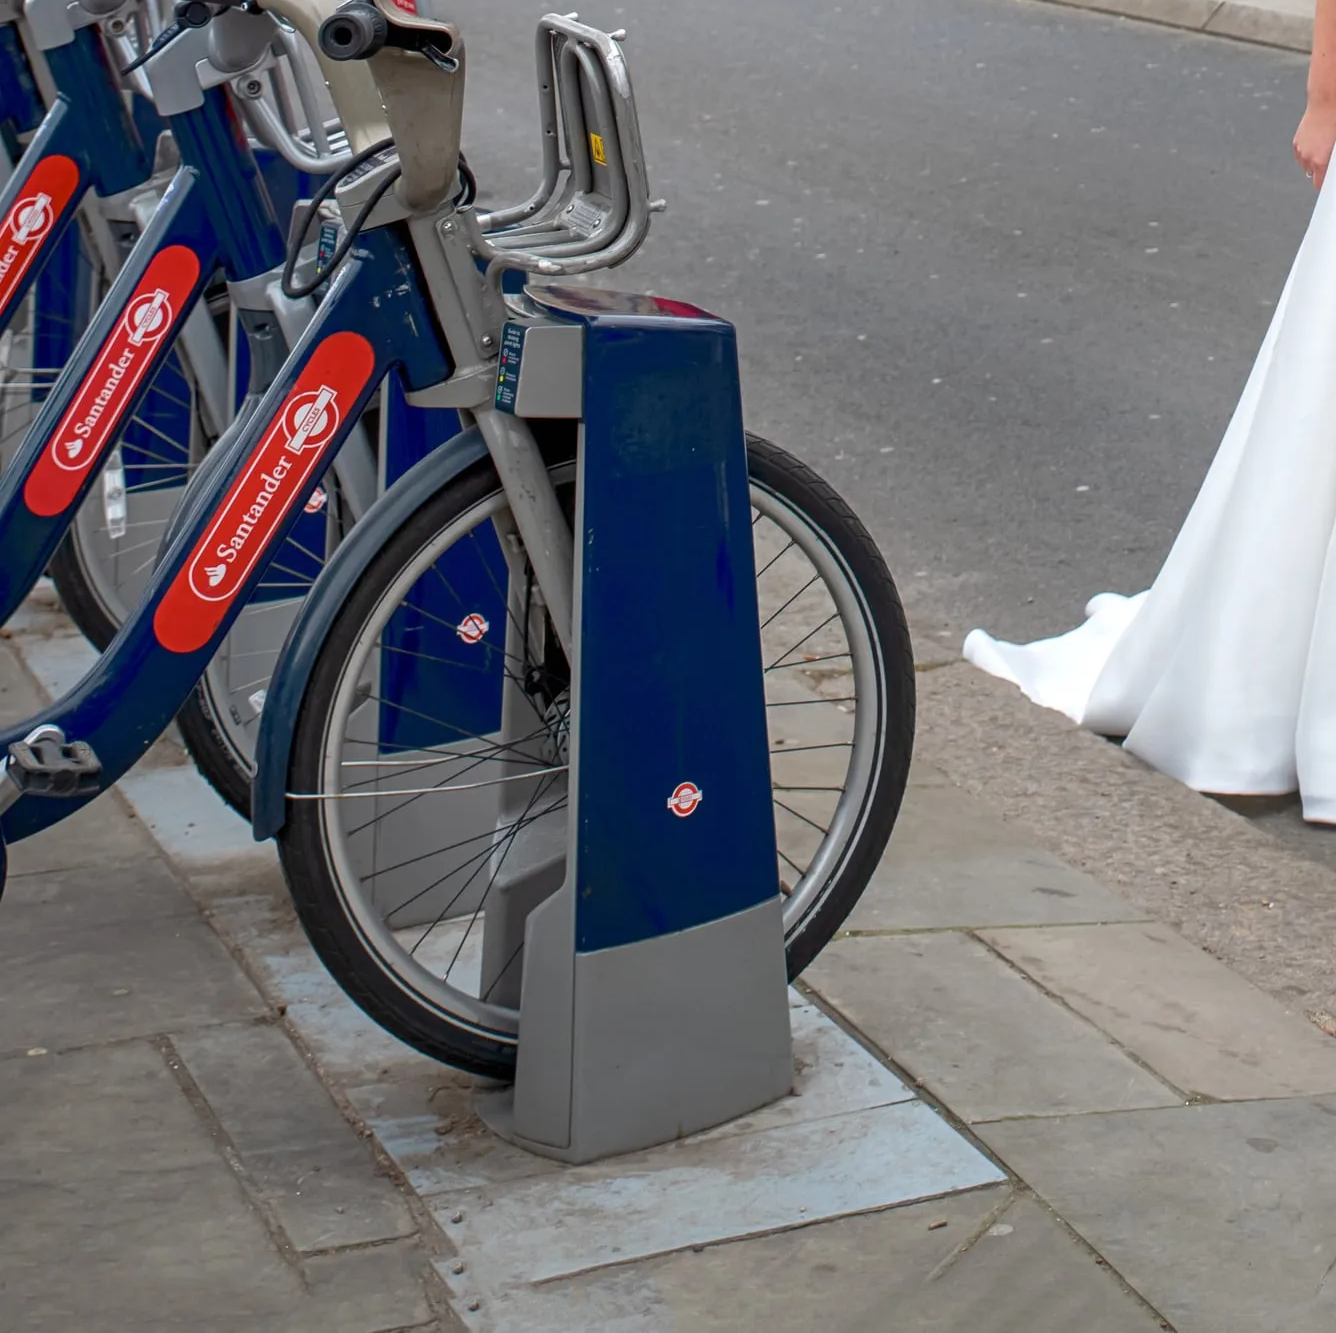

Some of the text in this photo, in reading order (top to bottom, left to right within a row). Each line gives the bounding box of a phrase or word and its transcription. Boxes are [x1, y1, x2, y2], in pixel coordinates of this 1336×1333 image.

[74, 347, 135, 439] Santander
[301, 406, 321, 434] CYCLES
[216, 454, 293, 564] Santander
